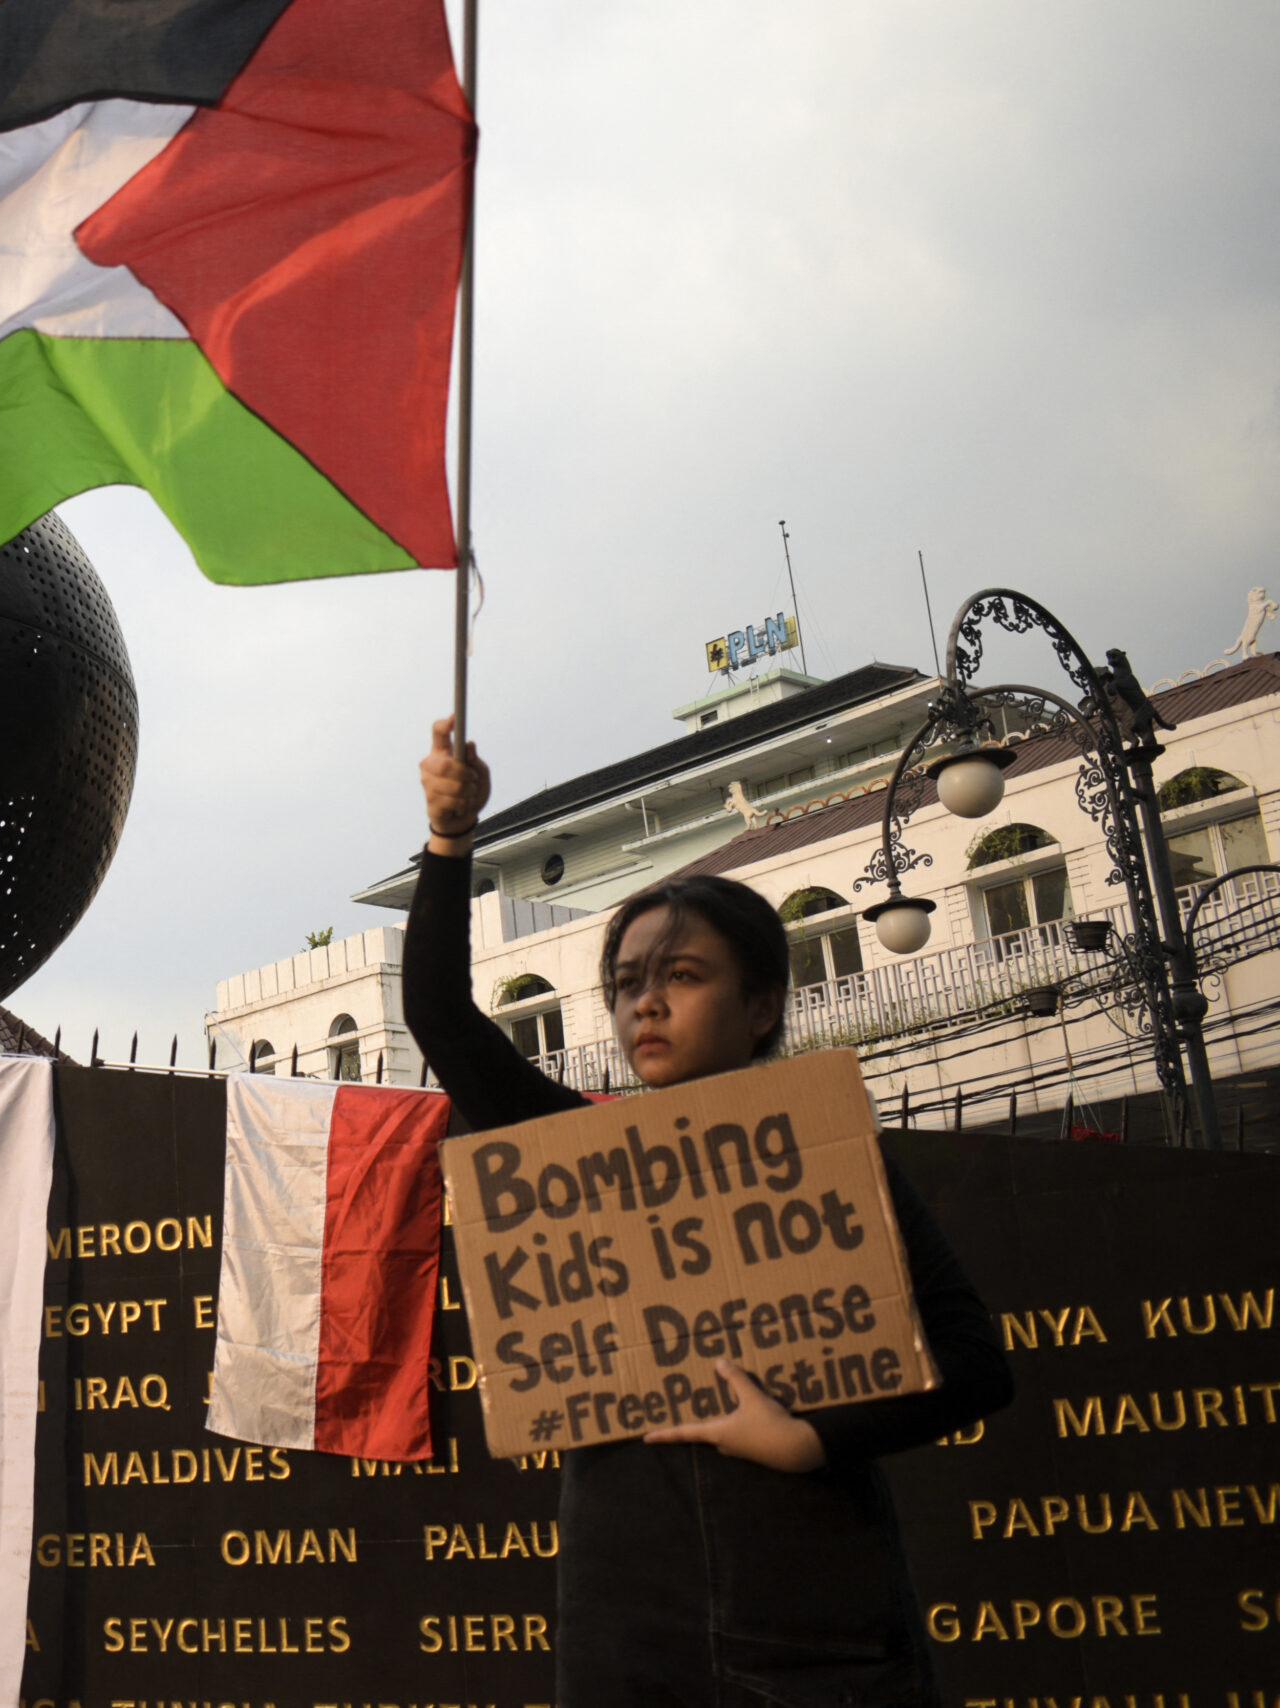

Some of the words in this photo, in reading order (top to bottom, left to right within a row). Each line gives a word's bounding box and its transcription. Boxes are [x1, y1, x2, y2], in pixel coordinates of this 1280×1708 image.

[728, 612, 788, 664] PLN
[471, 1112, 803, 1234] Bombing
[47, 1214, 213, 1260] MEROON
[483, 1230, 630, 1320] Kids
[645, 1213, 712, 1280] is
[733, 1189, 865, 1265] not
[44, 1298, 168, 1339] EGYPT
[495, 1318, 619, 1392] Self
[642, 1283, 877, 1368] Defense
[1001, 1305, 1109, 1351] NYA
[1141, 1287, 1275, 1339] KUW
[74, 1373, 172, 1412] IRAQ
[529, 1347, 903, 1442] #FreePalstine
[1053, 1382, 1280, 1438] MAURIT
[83, 1446, 291, 1486] MALDIVES
[968, 1491, 1159, 1540] PAPUA
[36, 1532, 156, 1567] GERIA
[221, 1527, 358, 1566] OMAN
[424, 1520, 559, 1561] PALAU
[103, 1616, 351, 1653] SEYCHELLES
[420, 1614, 552, 1653] SIERR
[926, 1594, 1162, 1643] GAPORE
